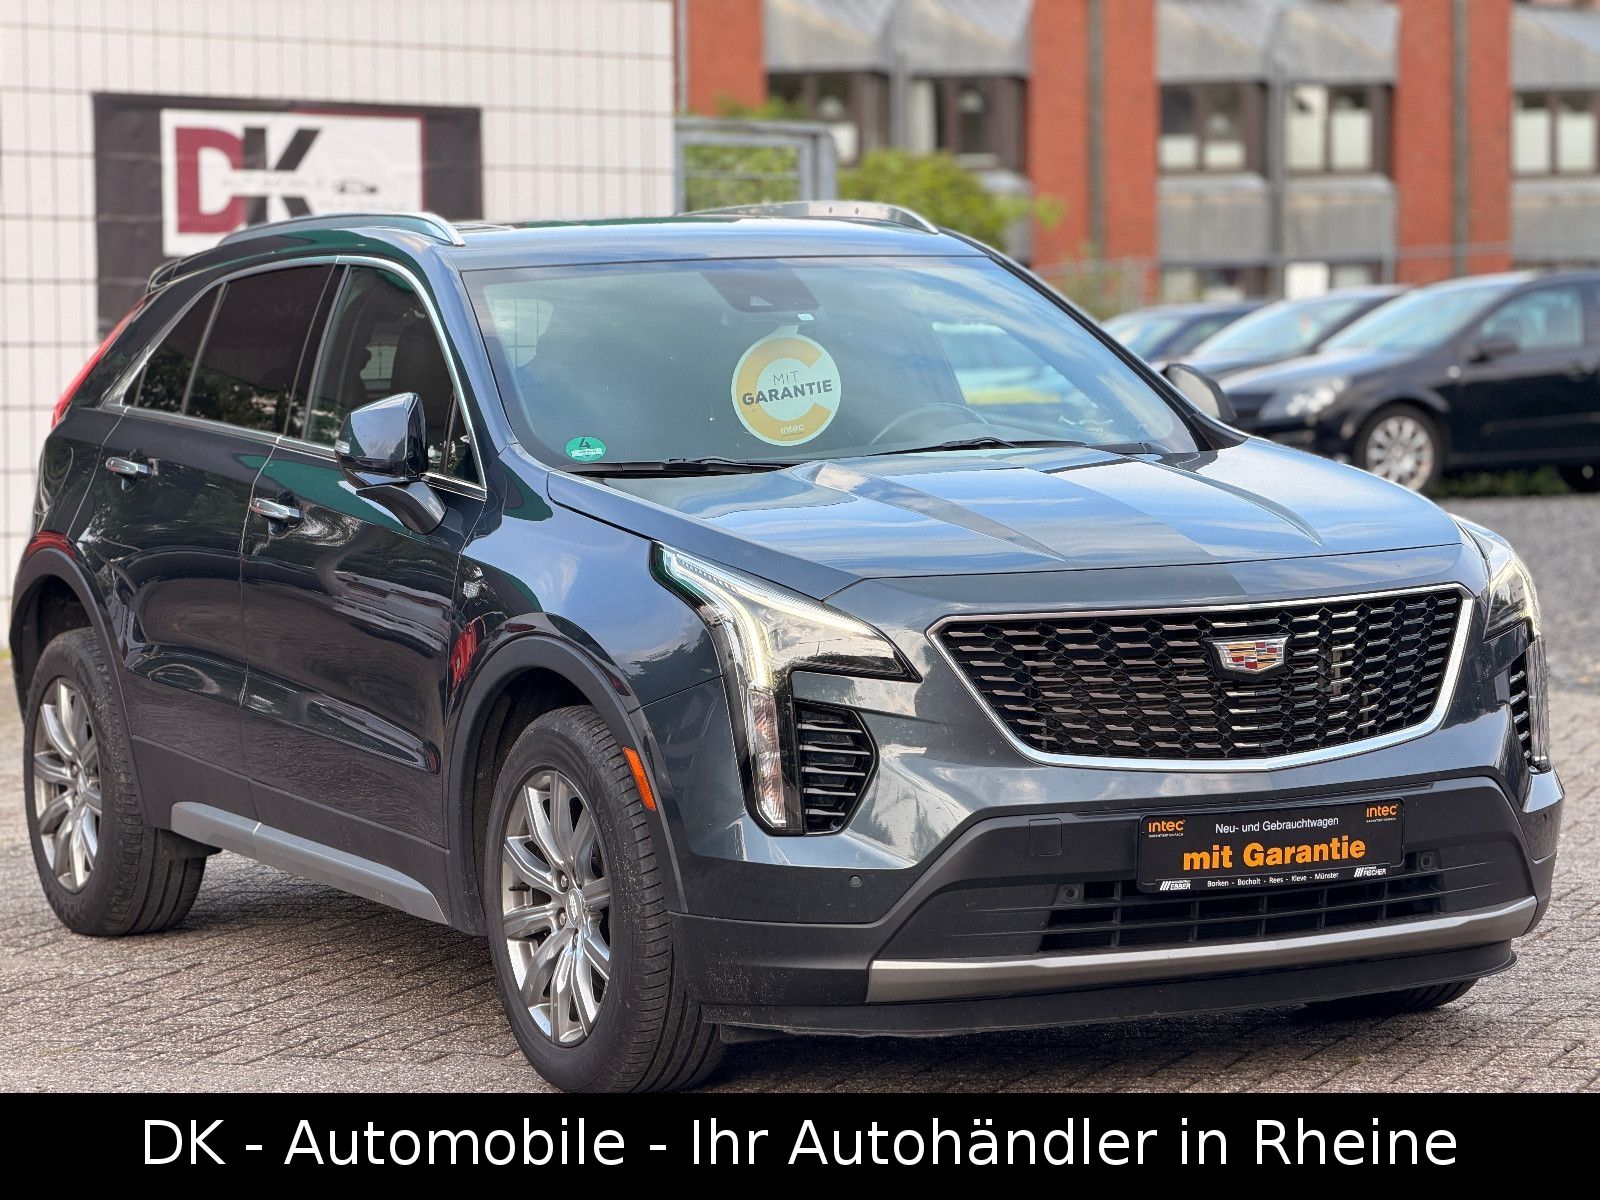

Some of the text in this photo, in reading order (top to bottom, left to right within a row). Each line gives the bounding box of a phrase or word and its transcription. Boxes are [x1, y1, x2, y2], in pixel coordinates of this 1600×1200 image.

[174, 127, 325, 234] DK
[773, 371, 798, 386] MIT
[742, 379, 833, 406] GARANTIE
[780, 423, 805, 435] intec
[579, 437, 592, 449] 4
[1366, 804, 1398, 818] intec
[1148, 819, 1185, 833] intec
[1215, 817, 1339, 834] Neu- und Gebrauchtwagen
[1183, 834, 1366, 871] mit Garantie
[1207, 880, 1229, 888] Borken
[1237, 877, 1261, 886] Bocholt
[1269, 876, 1284, 884] Rees
[1291, 874, 1307, 882] Kleve
[1315, 871, 1339, 880] Münster
